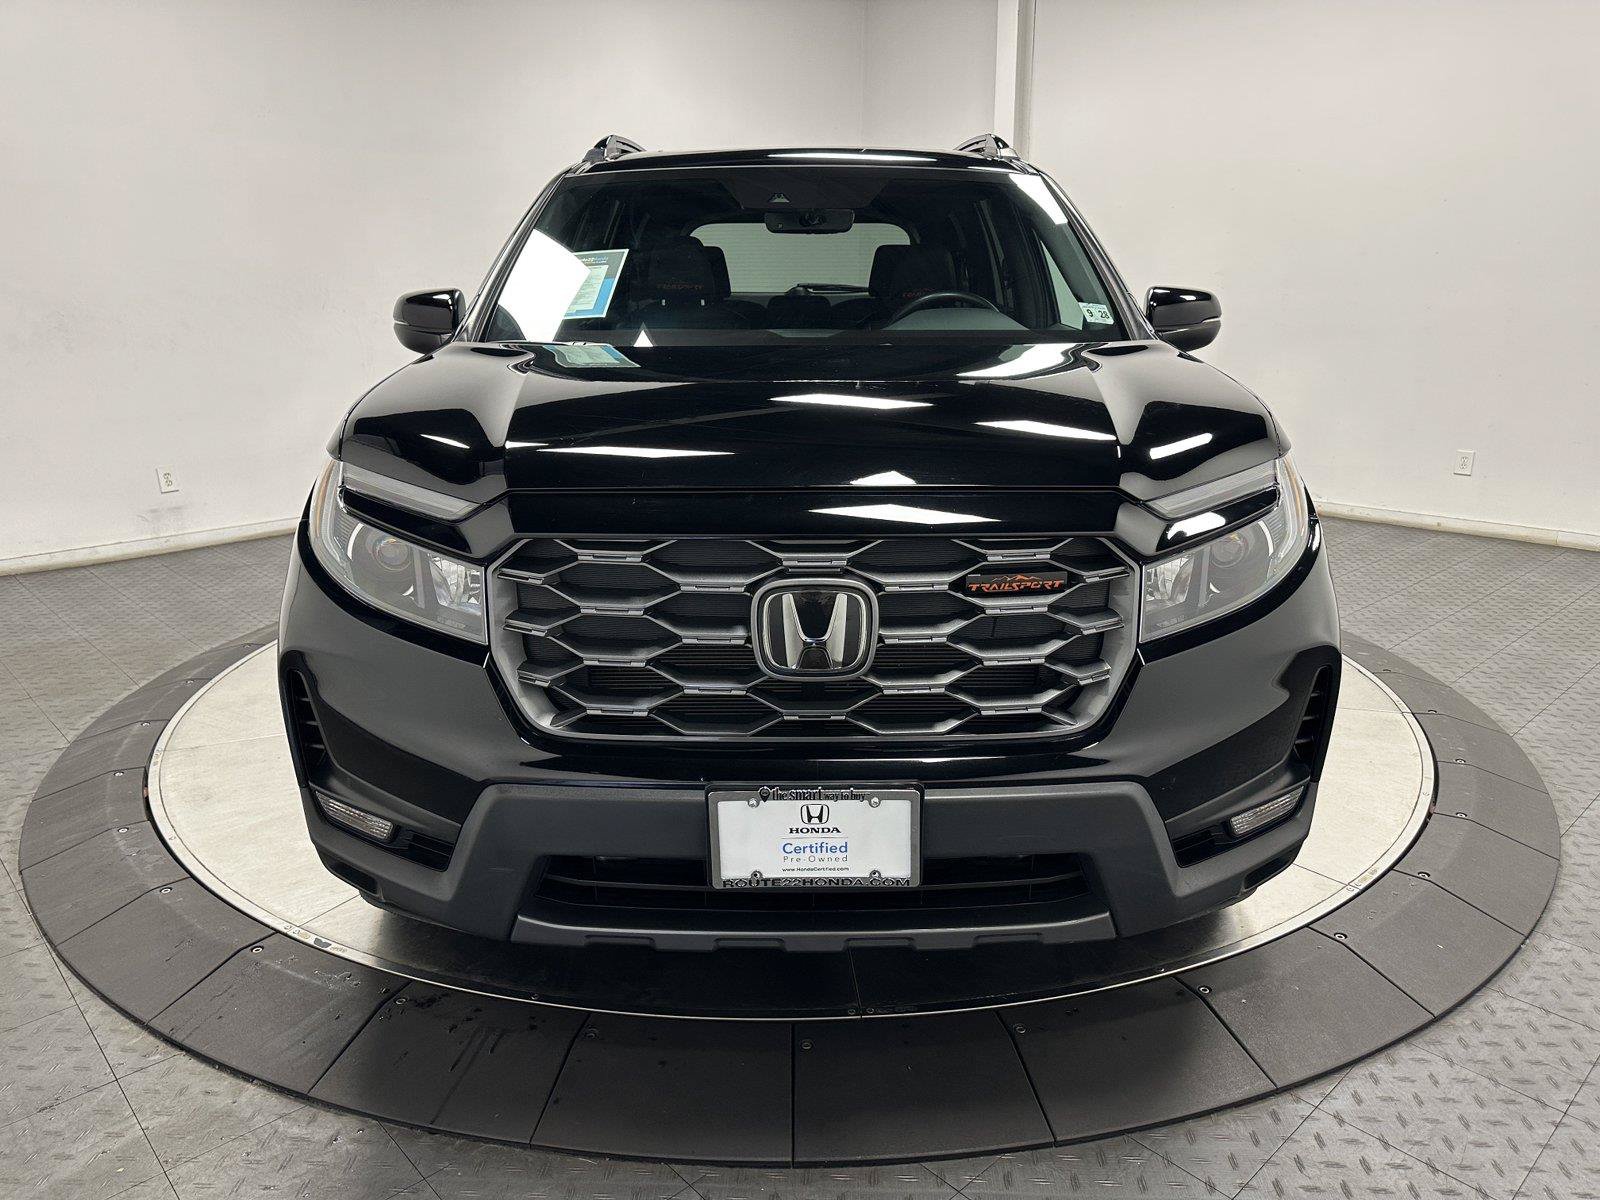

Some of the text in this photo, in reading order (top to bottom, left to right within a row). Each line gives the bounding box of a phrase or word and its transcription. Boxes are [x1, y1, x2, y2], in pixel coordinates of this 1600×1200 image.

[1086, 309, 1094, 317] 9
[968, 579, 1065, 592] TRAILSPORT
[772, 786, 866, 803] the smart way to buy
[782, 841, 848, 854] Certified
[783, 855, 848, 863] Pre-Owned
[722, 877, 910, 888] ROUTE22HONDA.COM
